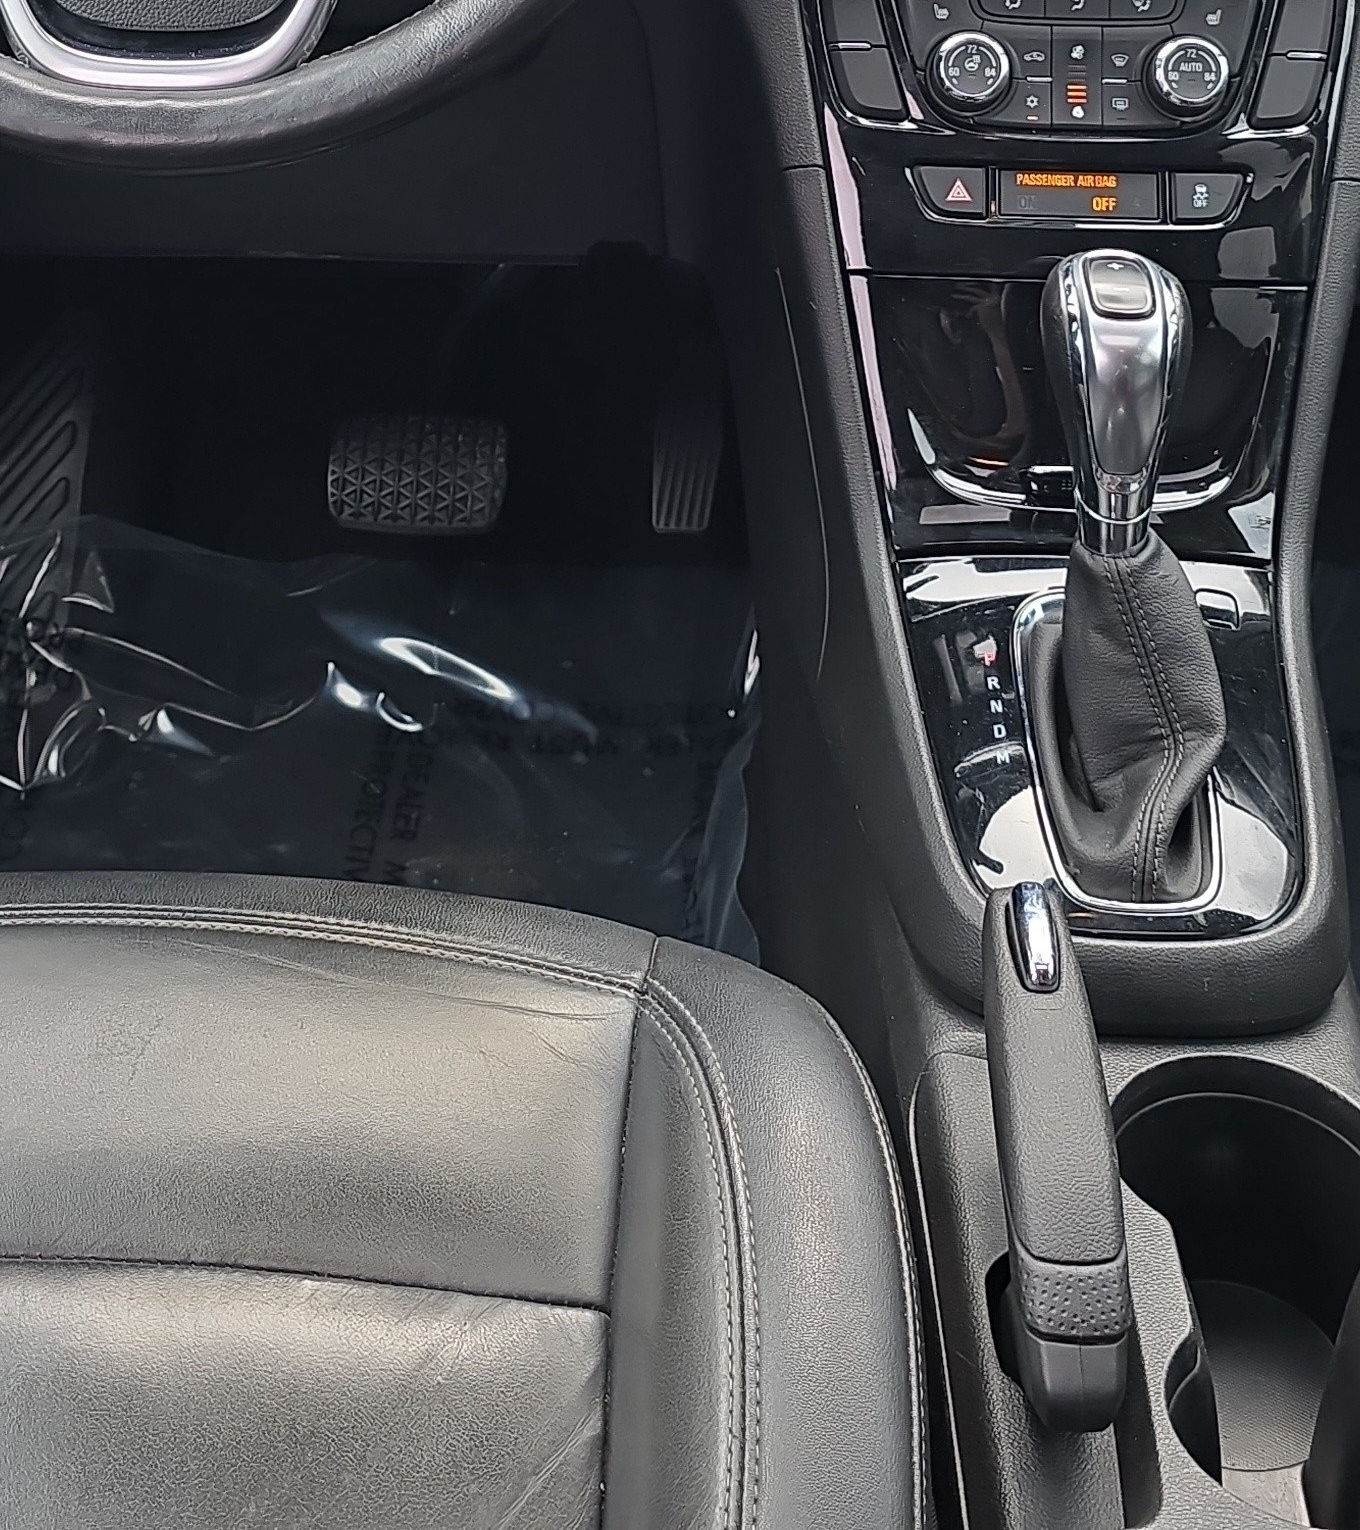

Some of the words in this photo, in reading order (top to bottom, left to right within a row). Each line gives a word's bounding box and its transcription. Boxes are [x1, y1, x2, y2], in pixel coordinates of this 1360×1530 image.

[966, 44, 978, 54] 72
[1186, 48, 1197, 58] 72
[948, 66, 960, 77] 60
[1179, 62, 1203, 72] AUTO
[1203, 72, 1216, 82] 84
[1016, 173, 1076, 187] PASSENGER
[1077, 174, 1095, 187] AIR
[1095, 175, 1118, 188] BAG
[1092, 196, 1118, 212] OFF
[1193, 199, 1209, 208] OFF
[986, 675, 1001, 690] R
[989, 699, 1004, 713] N
[992, 723, 1007, 739] D
[995, 750, 1011, 765] M
